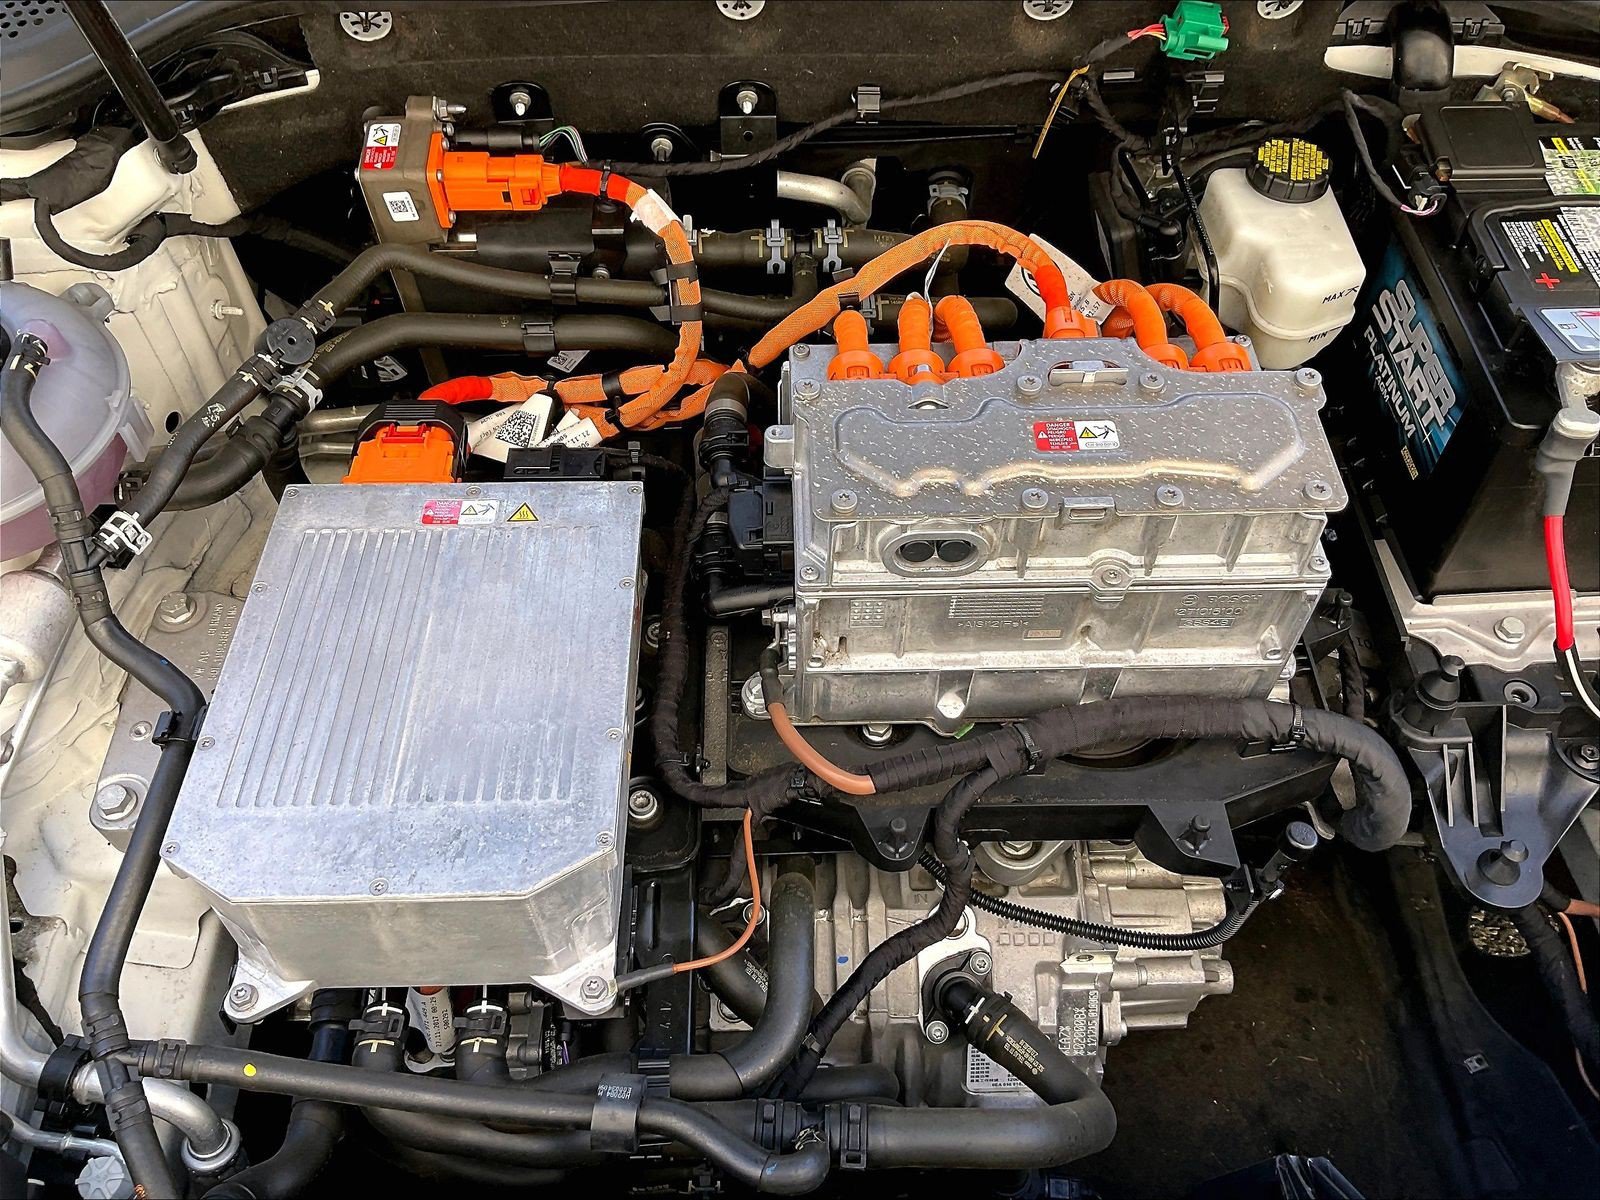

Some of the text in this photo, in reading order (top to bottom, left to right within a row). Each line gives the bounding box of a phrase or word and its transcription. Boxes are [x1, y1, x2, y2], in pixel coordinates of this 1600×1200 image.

[1322, 290, 1345, 304] MAX
[1307, 331, 1328, 343] MIN
[1395, 281, 1456, 417] SUPER
[1372, 289, 1446, 427] START
[1363, 325, 1416, 438] PLATINUM
[1207, 593, 1263, 604] BOSCH
[913, 894, 928, 904] IN
